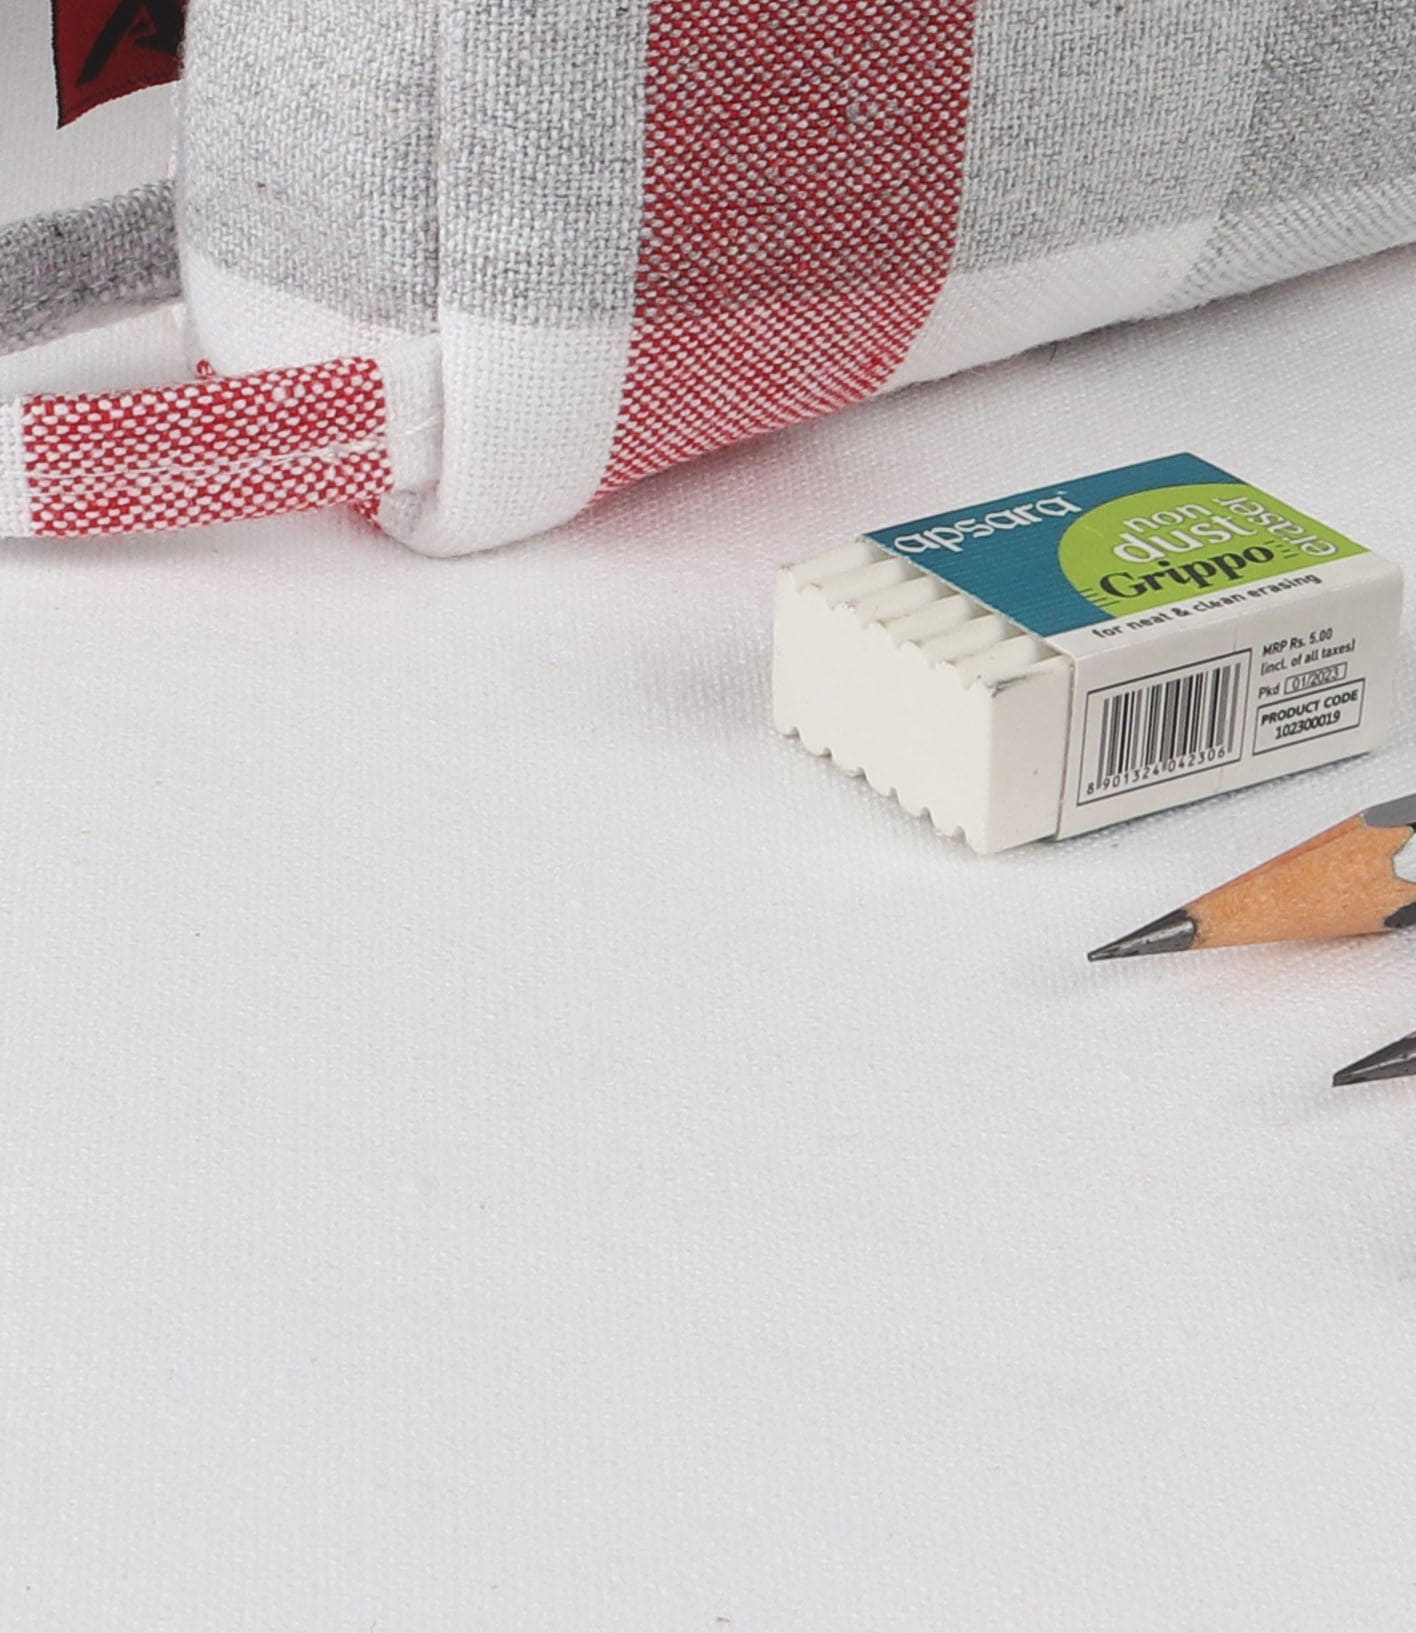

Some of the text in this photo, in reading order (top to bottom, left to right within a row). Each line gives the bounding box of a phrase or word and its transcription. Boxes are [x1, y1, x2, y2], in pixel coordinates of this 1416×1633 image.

[894, 496, 1082, 553] apsara
[1123, 504, 1212, 533] non
[1213, 496, 1337, 556] eraser
[1113, 515, 1257, 563] dust
[1100, 546, 1274, 598] Grippo
[1092, 573, 1322, 639] for neat & clean erasing
[1262, 628, 1333, 657] MRP Rs. 5.00
[1291, 653, 1303, 667] of
[1304, 649, 1319, 664] all
[1258, 667, 1340, 700] Pkd 01/2023
[1261, 689, 1359, 726] PRODUCT CODE
[1275, 710, 1341, 740] 102300019
